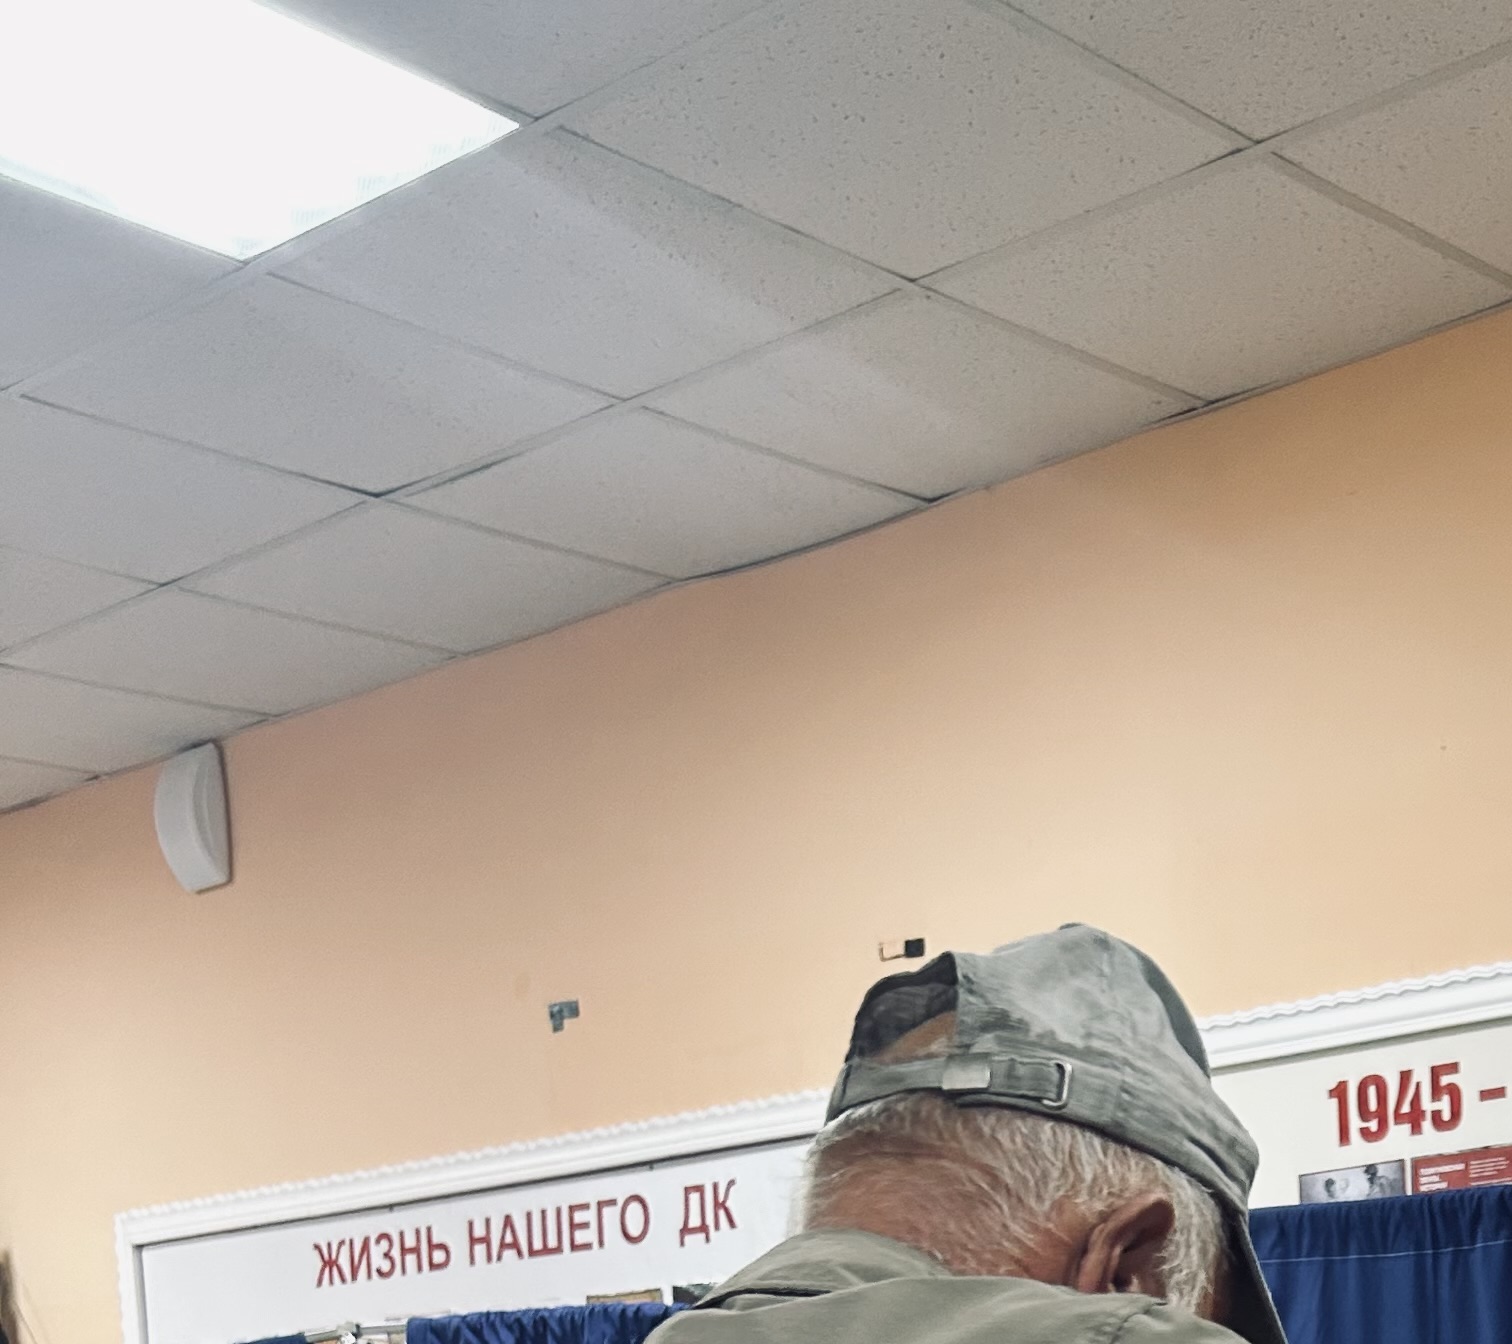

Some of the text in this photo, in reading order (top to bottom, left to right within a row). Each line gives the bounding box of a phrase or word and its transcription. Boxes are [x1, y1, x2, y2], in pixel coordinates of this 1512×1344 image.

[1329, 1062, 1462, 1147] 1945
[313, 1178, 738, 1288] ЖИЗНЬ НАШЕГО ДК
